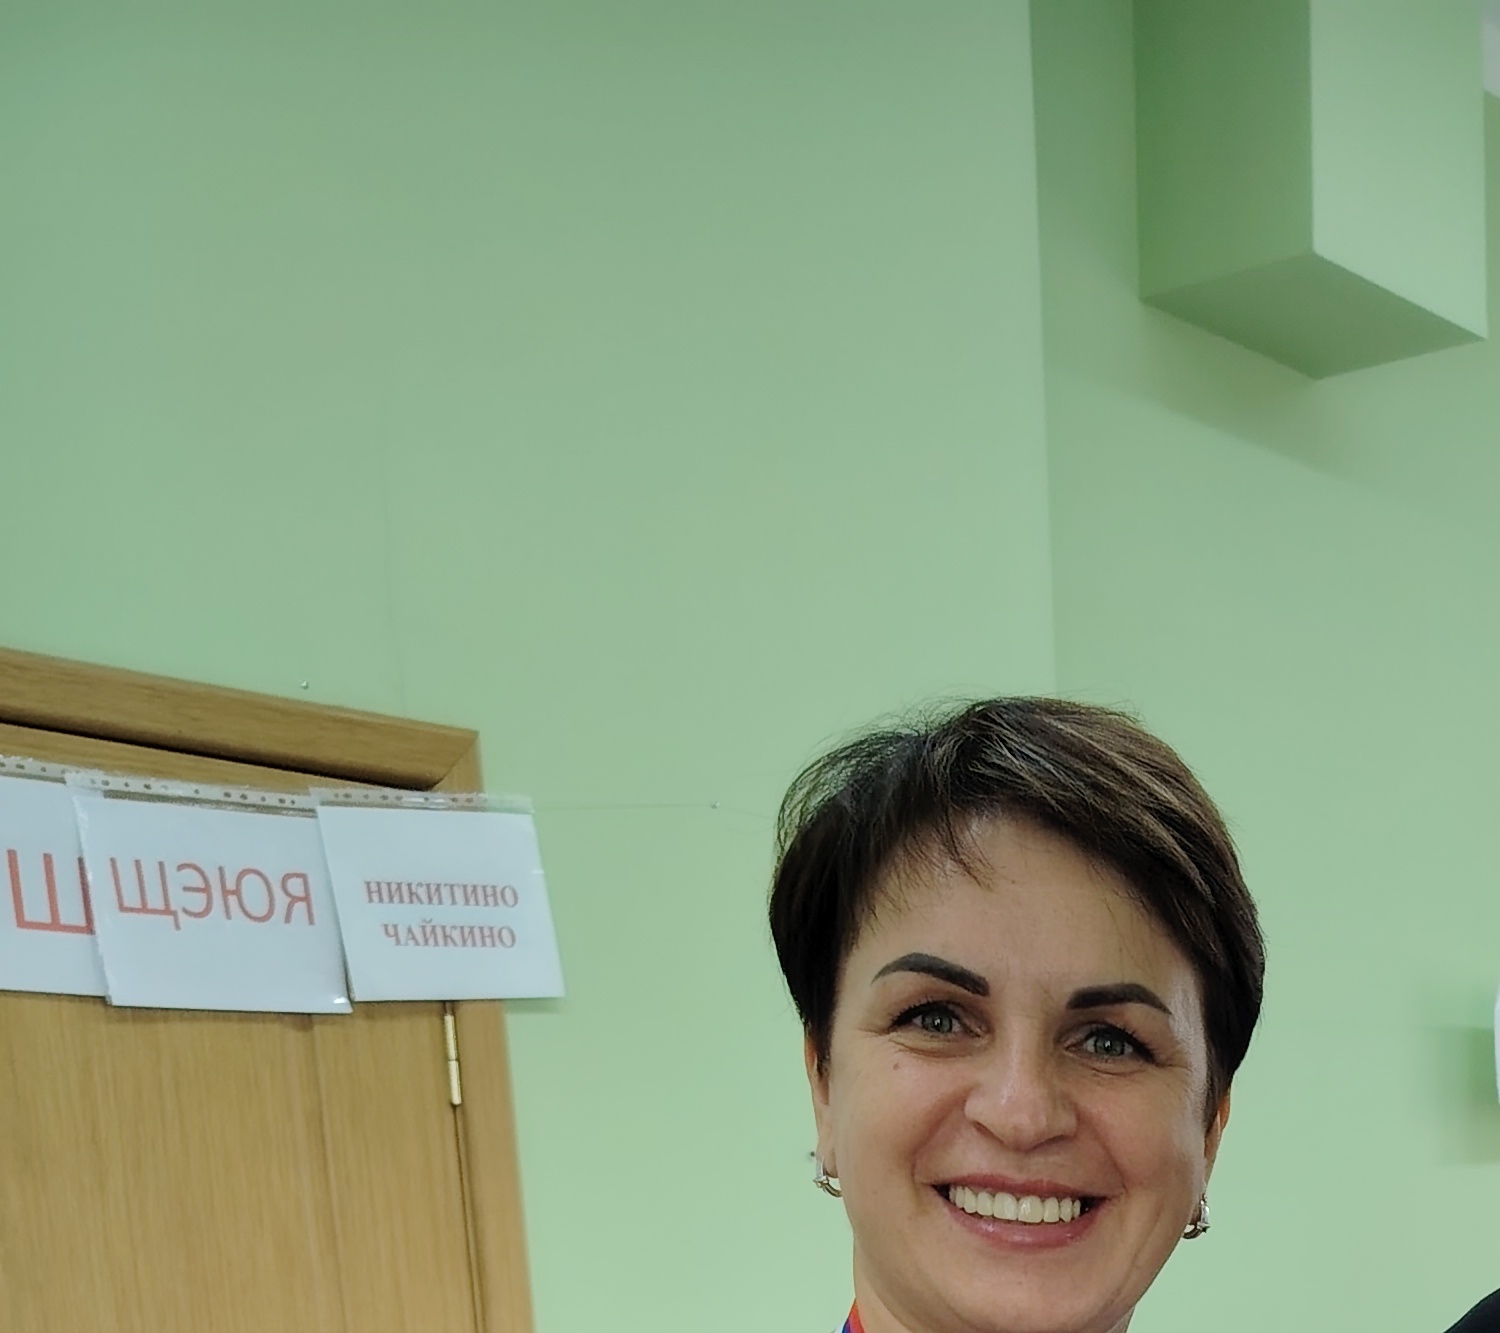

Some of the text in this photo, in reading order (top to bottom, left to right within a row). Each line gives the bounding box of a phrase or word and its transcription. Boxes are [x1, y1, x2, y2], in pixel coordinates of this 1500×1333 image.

[7, 848, 96, 935] Ш
[109, 857, 316, 931] ЩЭЮЯ
[364, 880, 520, 908] НИКИТИНО
[381, 918, 517, 949] ЧАЙКИНО
